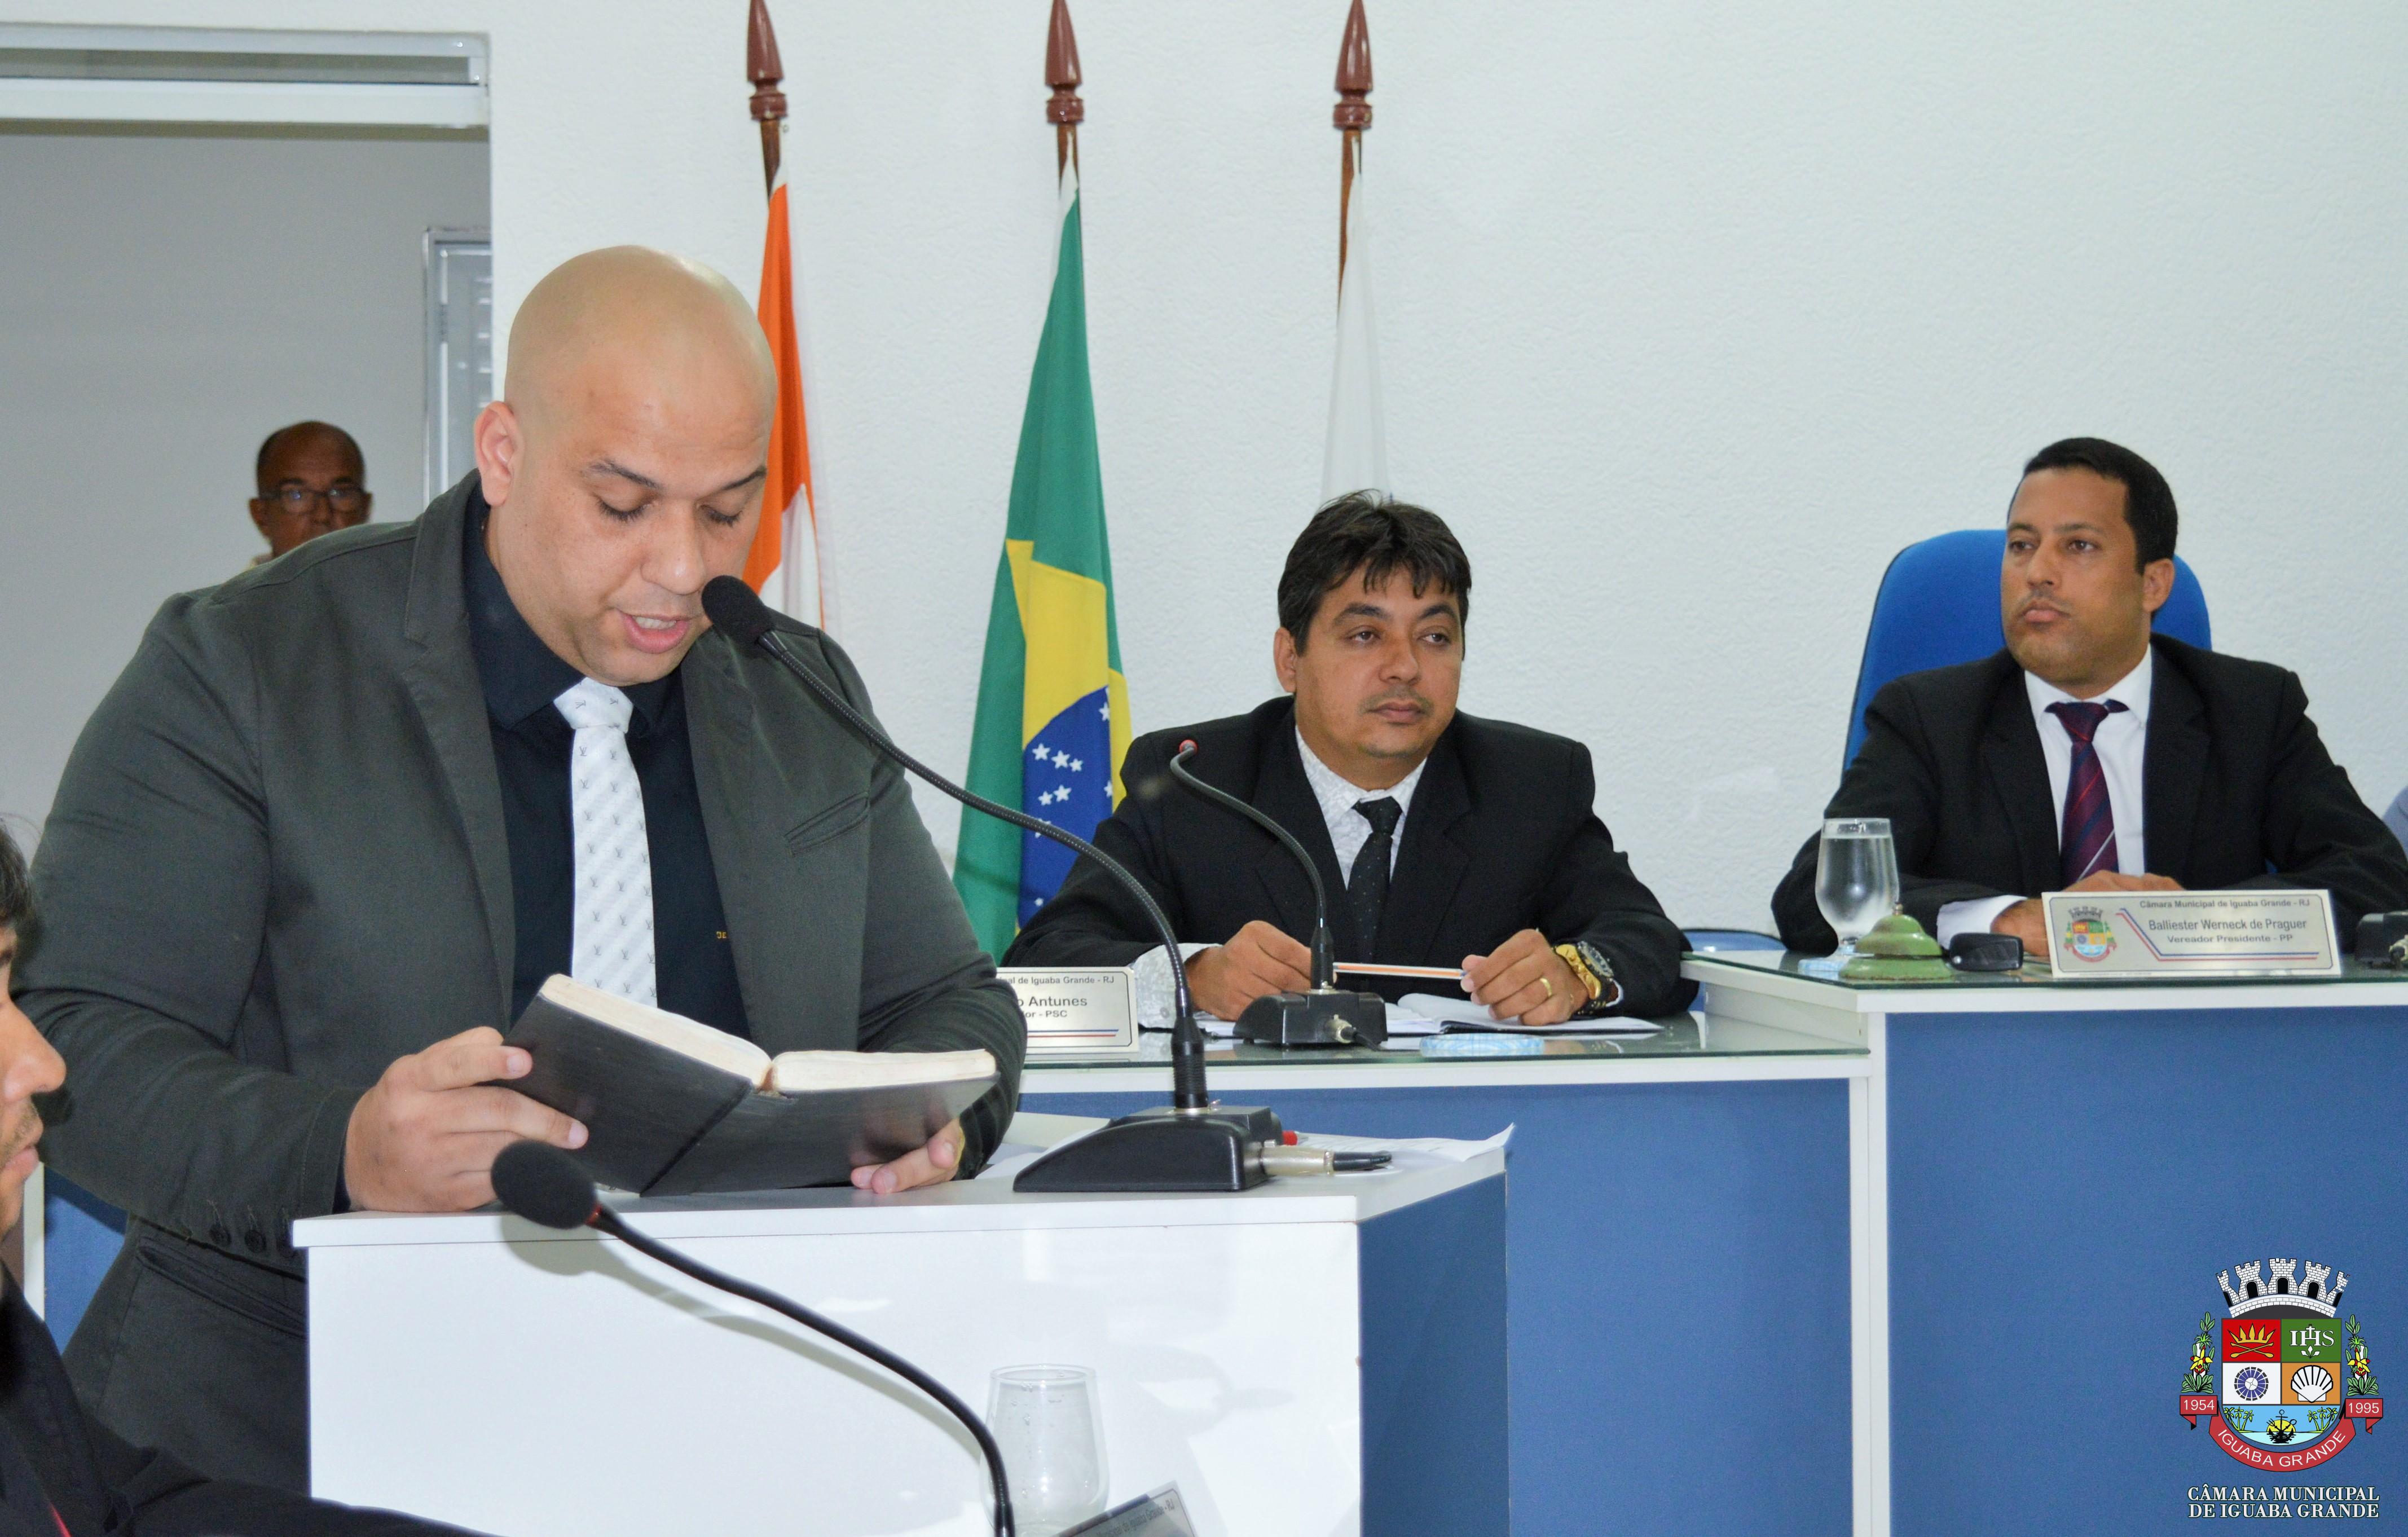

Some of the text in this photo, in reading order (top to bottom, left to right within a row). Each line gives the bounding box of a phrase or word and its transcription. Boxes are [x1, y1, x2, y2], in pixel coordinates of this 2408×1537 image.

[2175, 900, 2215, 909] Municipal
[2230, 900, 2258, 909] Iguaba
[2149, 918, 2307, 931] Balliester Werneck de Praguer
[1031, 976, 1060, 985] Iguaba
[1029, 996, 1088, 1006] Antunes
